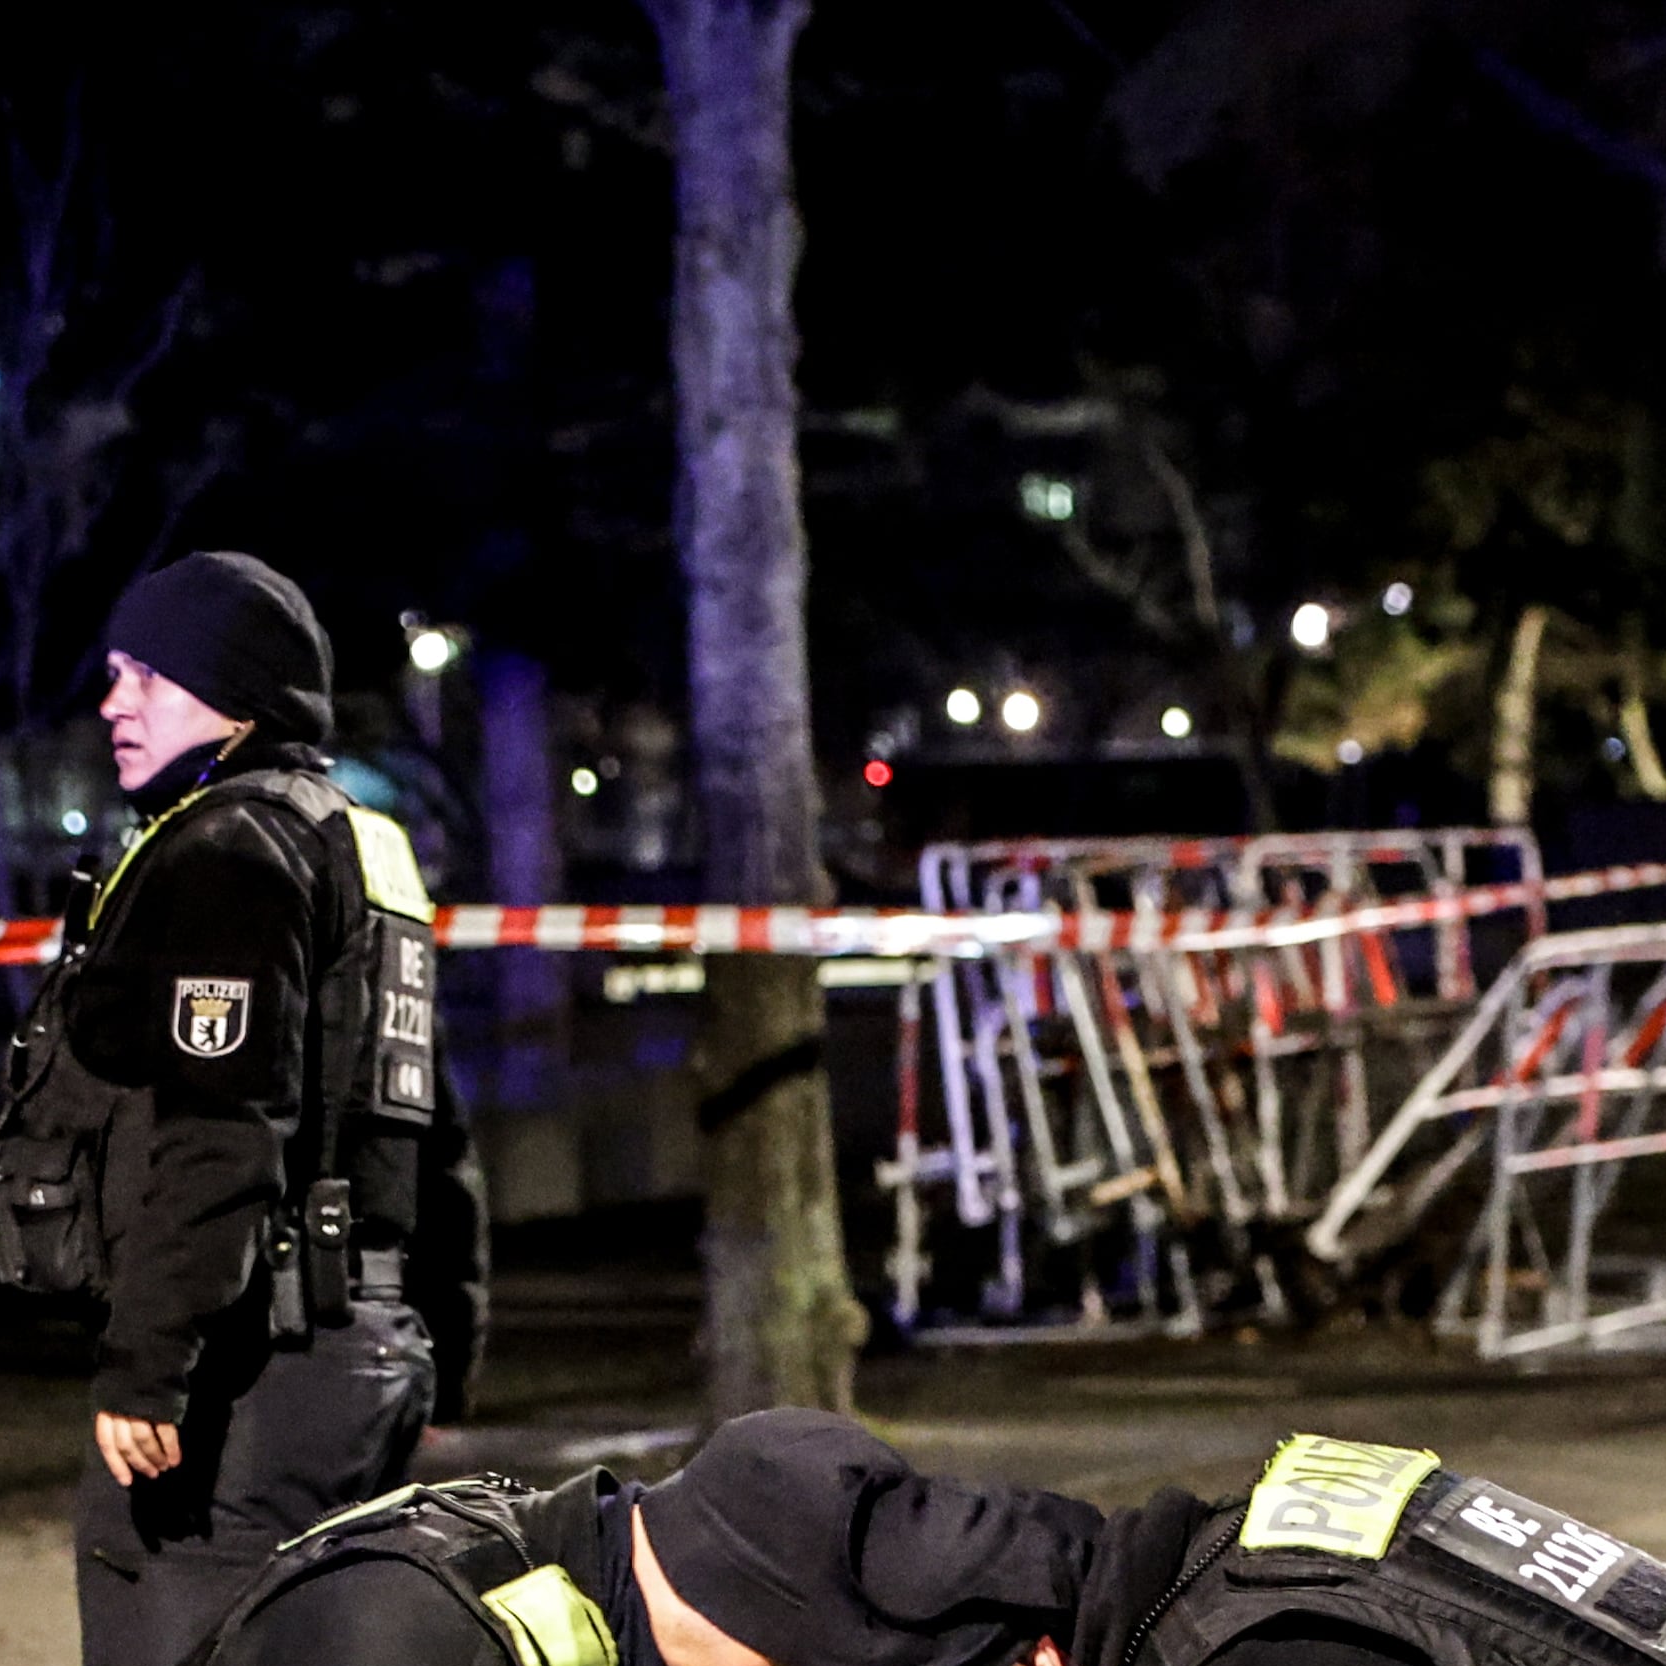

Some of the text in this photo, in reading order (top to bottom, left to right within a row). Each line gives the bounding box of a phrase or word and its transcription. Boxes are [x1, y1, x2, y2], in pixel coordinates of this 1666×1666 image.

[383, 990, 429, 1047] 2121
[1460, 1495, 1542, 1548] BE
[1519, 1521, 1625, 1602] 21126
